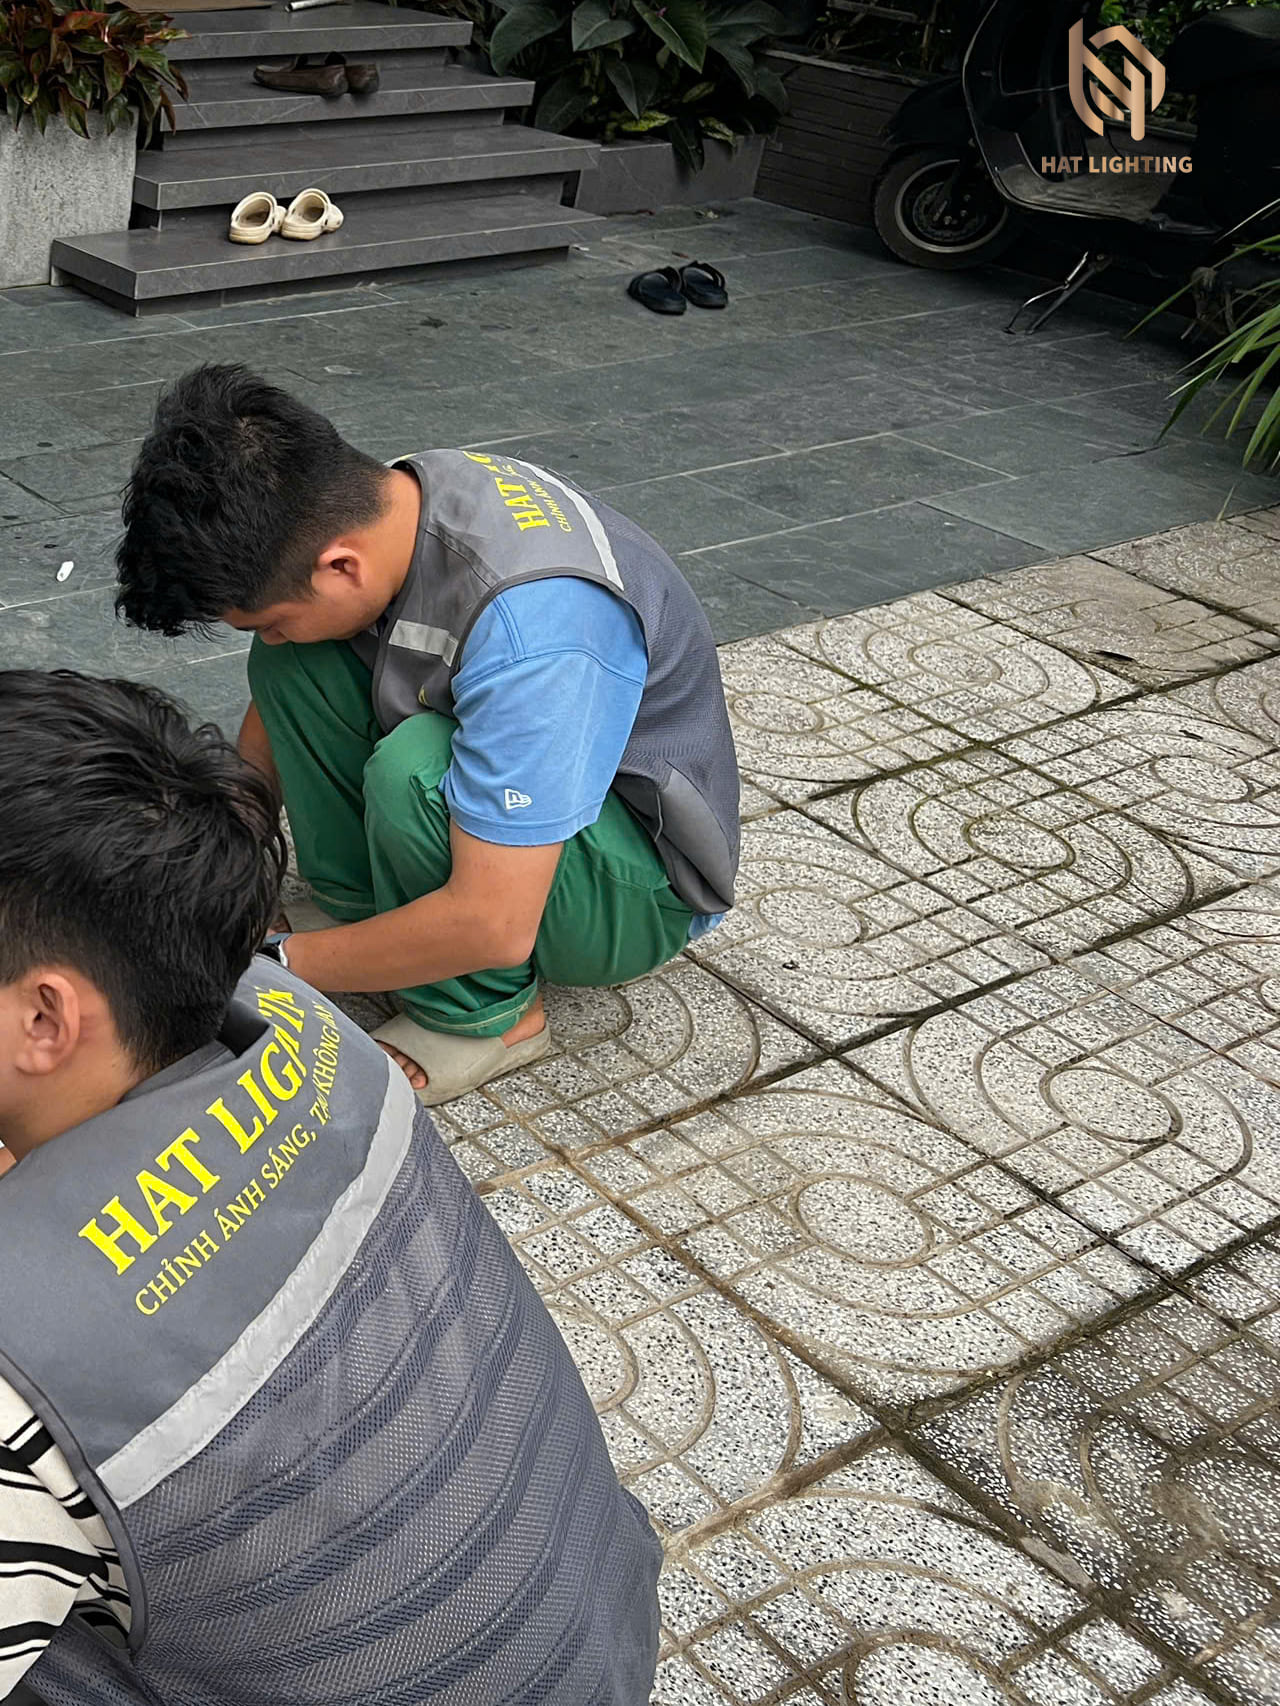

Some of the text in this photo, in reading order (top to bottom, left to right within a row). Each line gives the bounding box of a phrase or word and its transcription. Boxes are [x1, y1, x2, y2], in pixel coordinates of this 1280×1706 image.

[495, 477, 551, 531] HAT
[78, 1127, 221, 1275] HAT
[135, 1229, 220, 1315] CHỈNH
[214, 1178, 266, 1241] ÁNH
[261, 1123, 318, 1190] SÁNG,
[312, 1025, 340, 1096] KHÔNG
